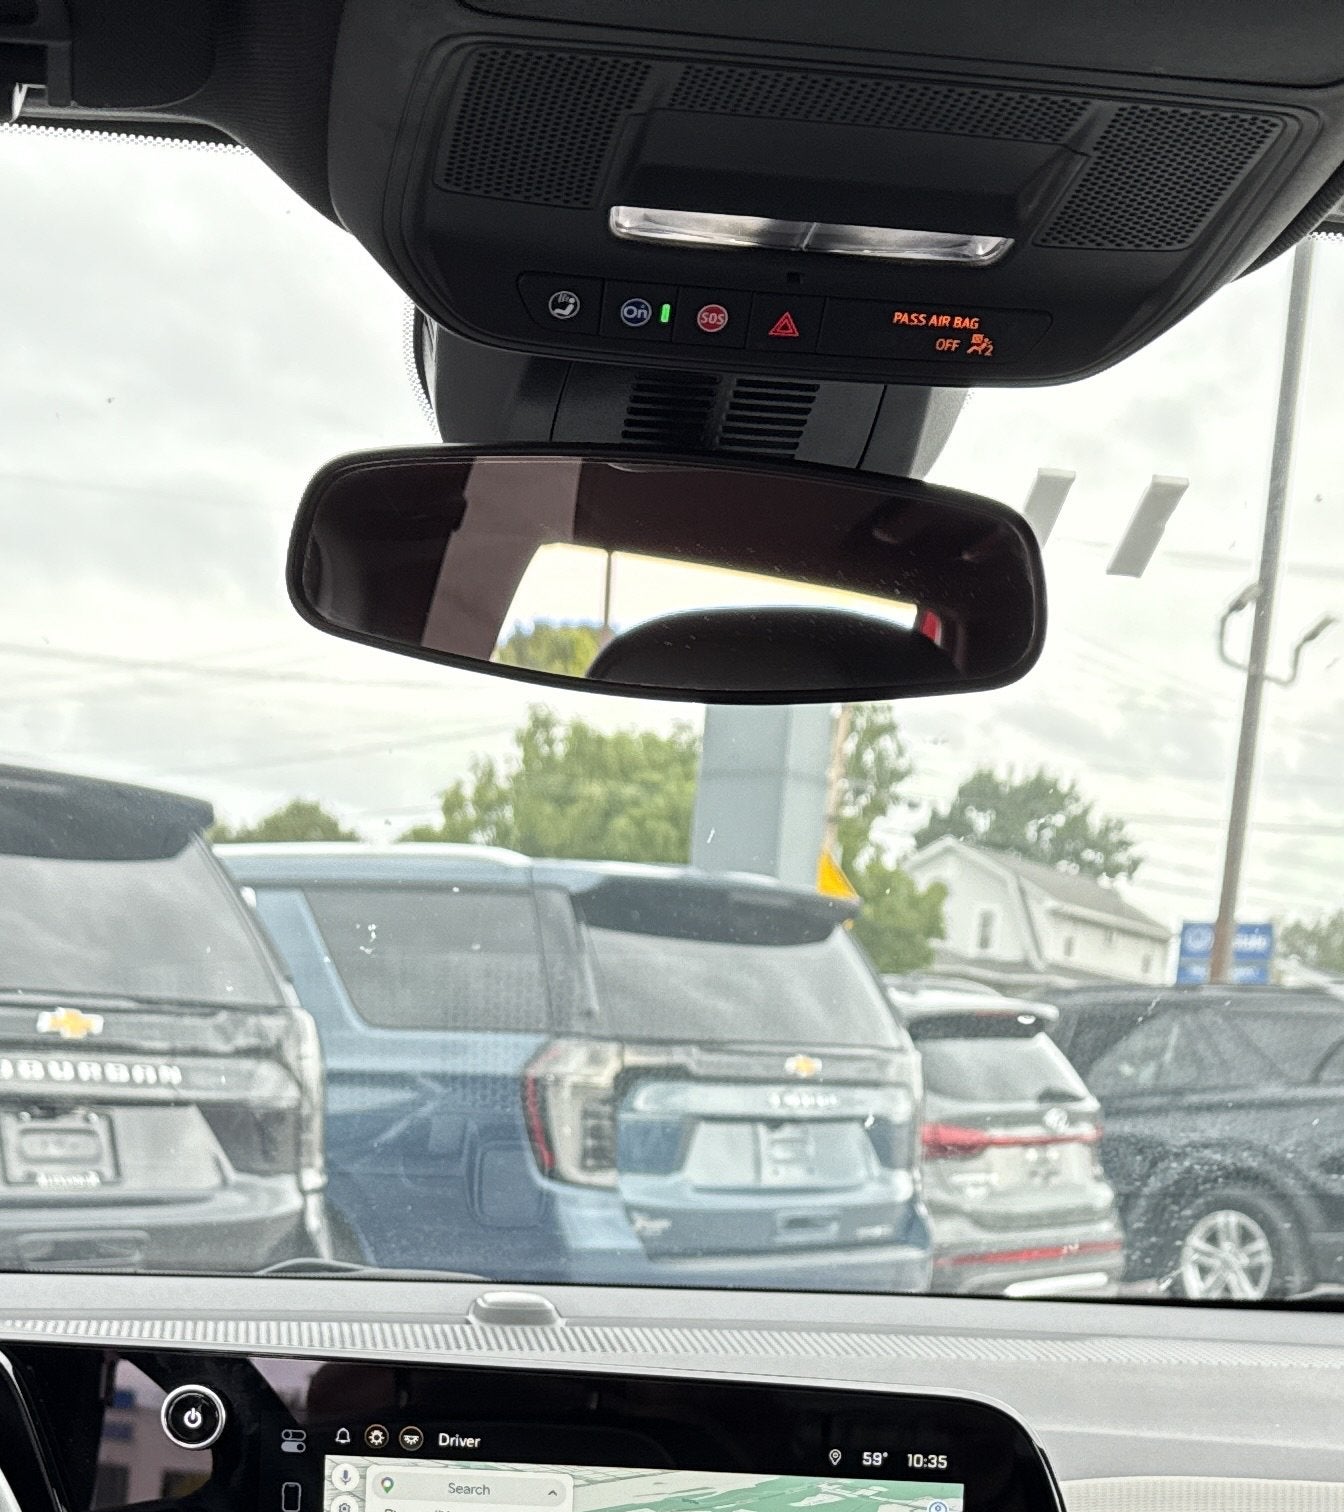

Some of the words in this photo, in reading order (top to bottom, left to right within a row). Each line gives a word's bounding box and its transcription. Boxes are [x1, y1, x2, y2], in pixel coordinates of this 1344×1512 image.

[701, 312, 725, 326] SOS
[893, 312, 927, 326] PASS
[928, 315, 952, 328] AIR
[953, 317, 981, 330] BAG
[935, 339, 961, 352] OFF
[438, 1433, 482, 1449] Driver
[861, 1452, 889, 1467] 59°
[907, 1453, 949, 1470] 10:35
[448, 1481, 491, 1498] Search
